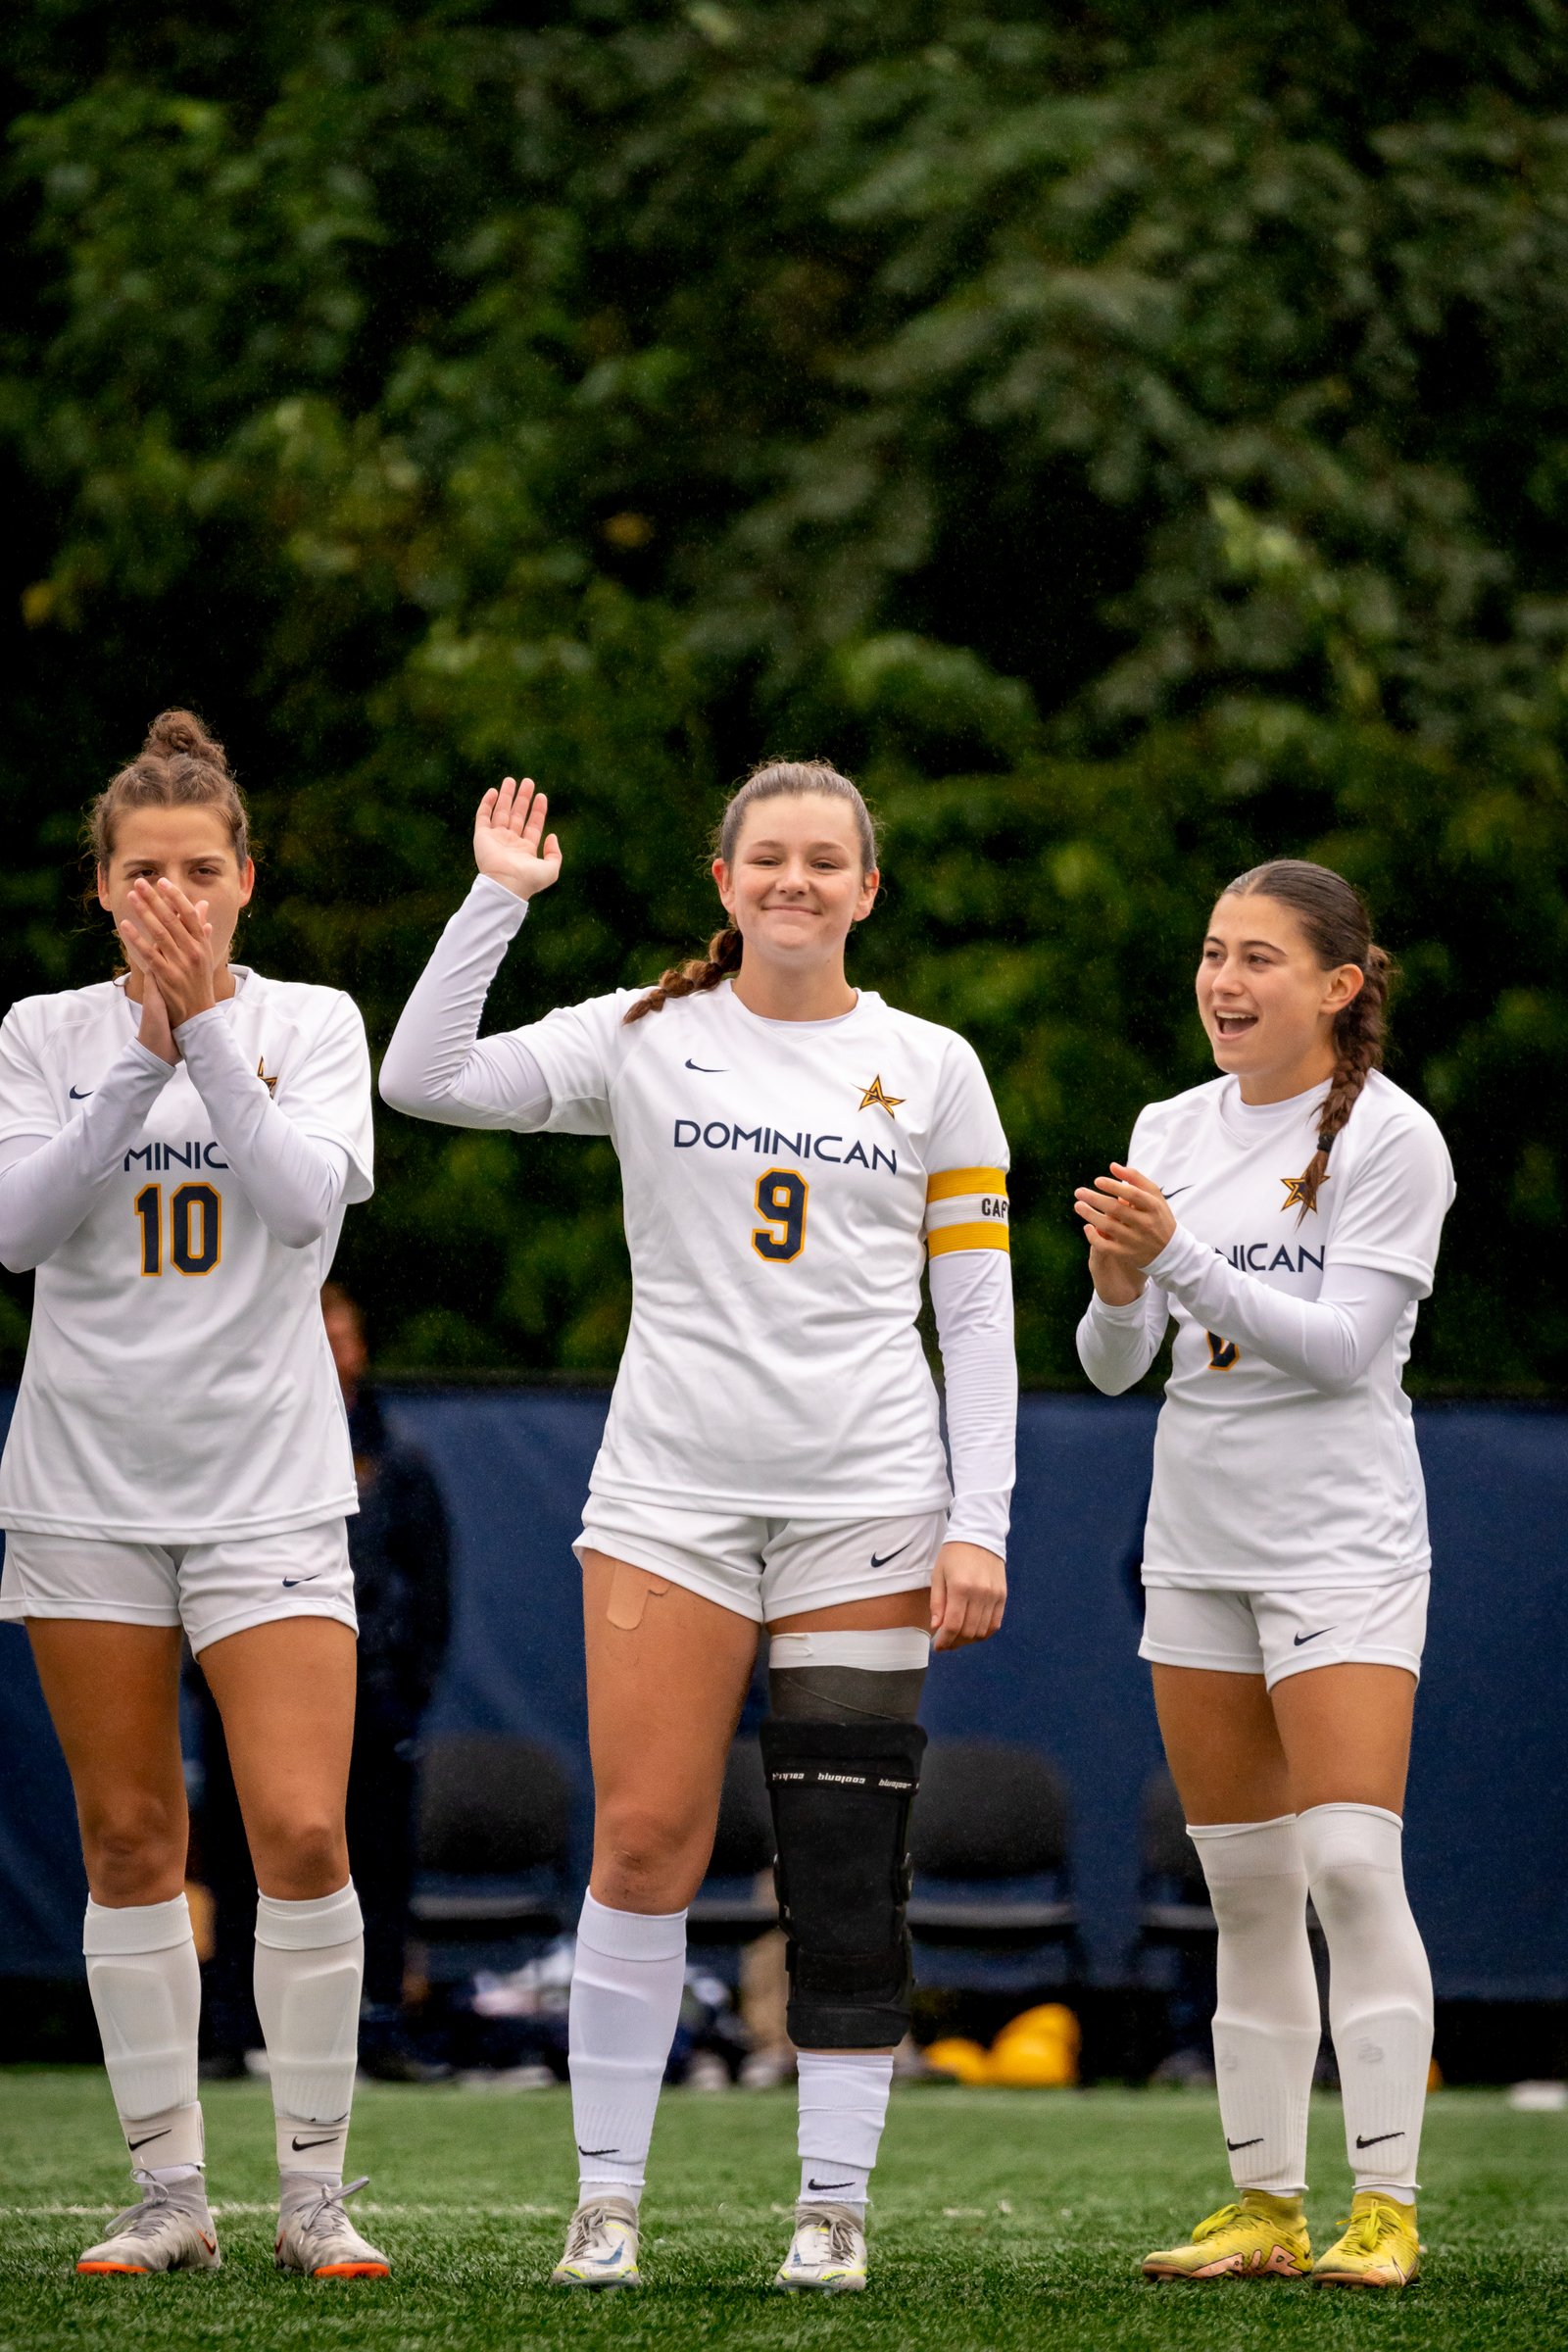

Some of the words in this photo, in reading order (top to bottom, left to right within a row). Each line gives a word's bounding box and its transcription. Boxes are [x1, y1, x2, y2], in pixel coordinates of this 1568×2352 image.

[673, 1119, 898, 1175] DOMINICAN
[134, 1182, 222, 1277] 10
[751, 1167, 809, 1264] 9
[981, 1198, 1008, 1218] CAP
